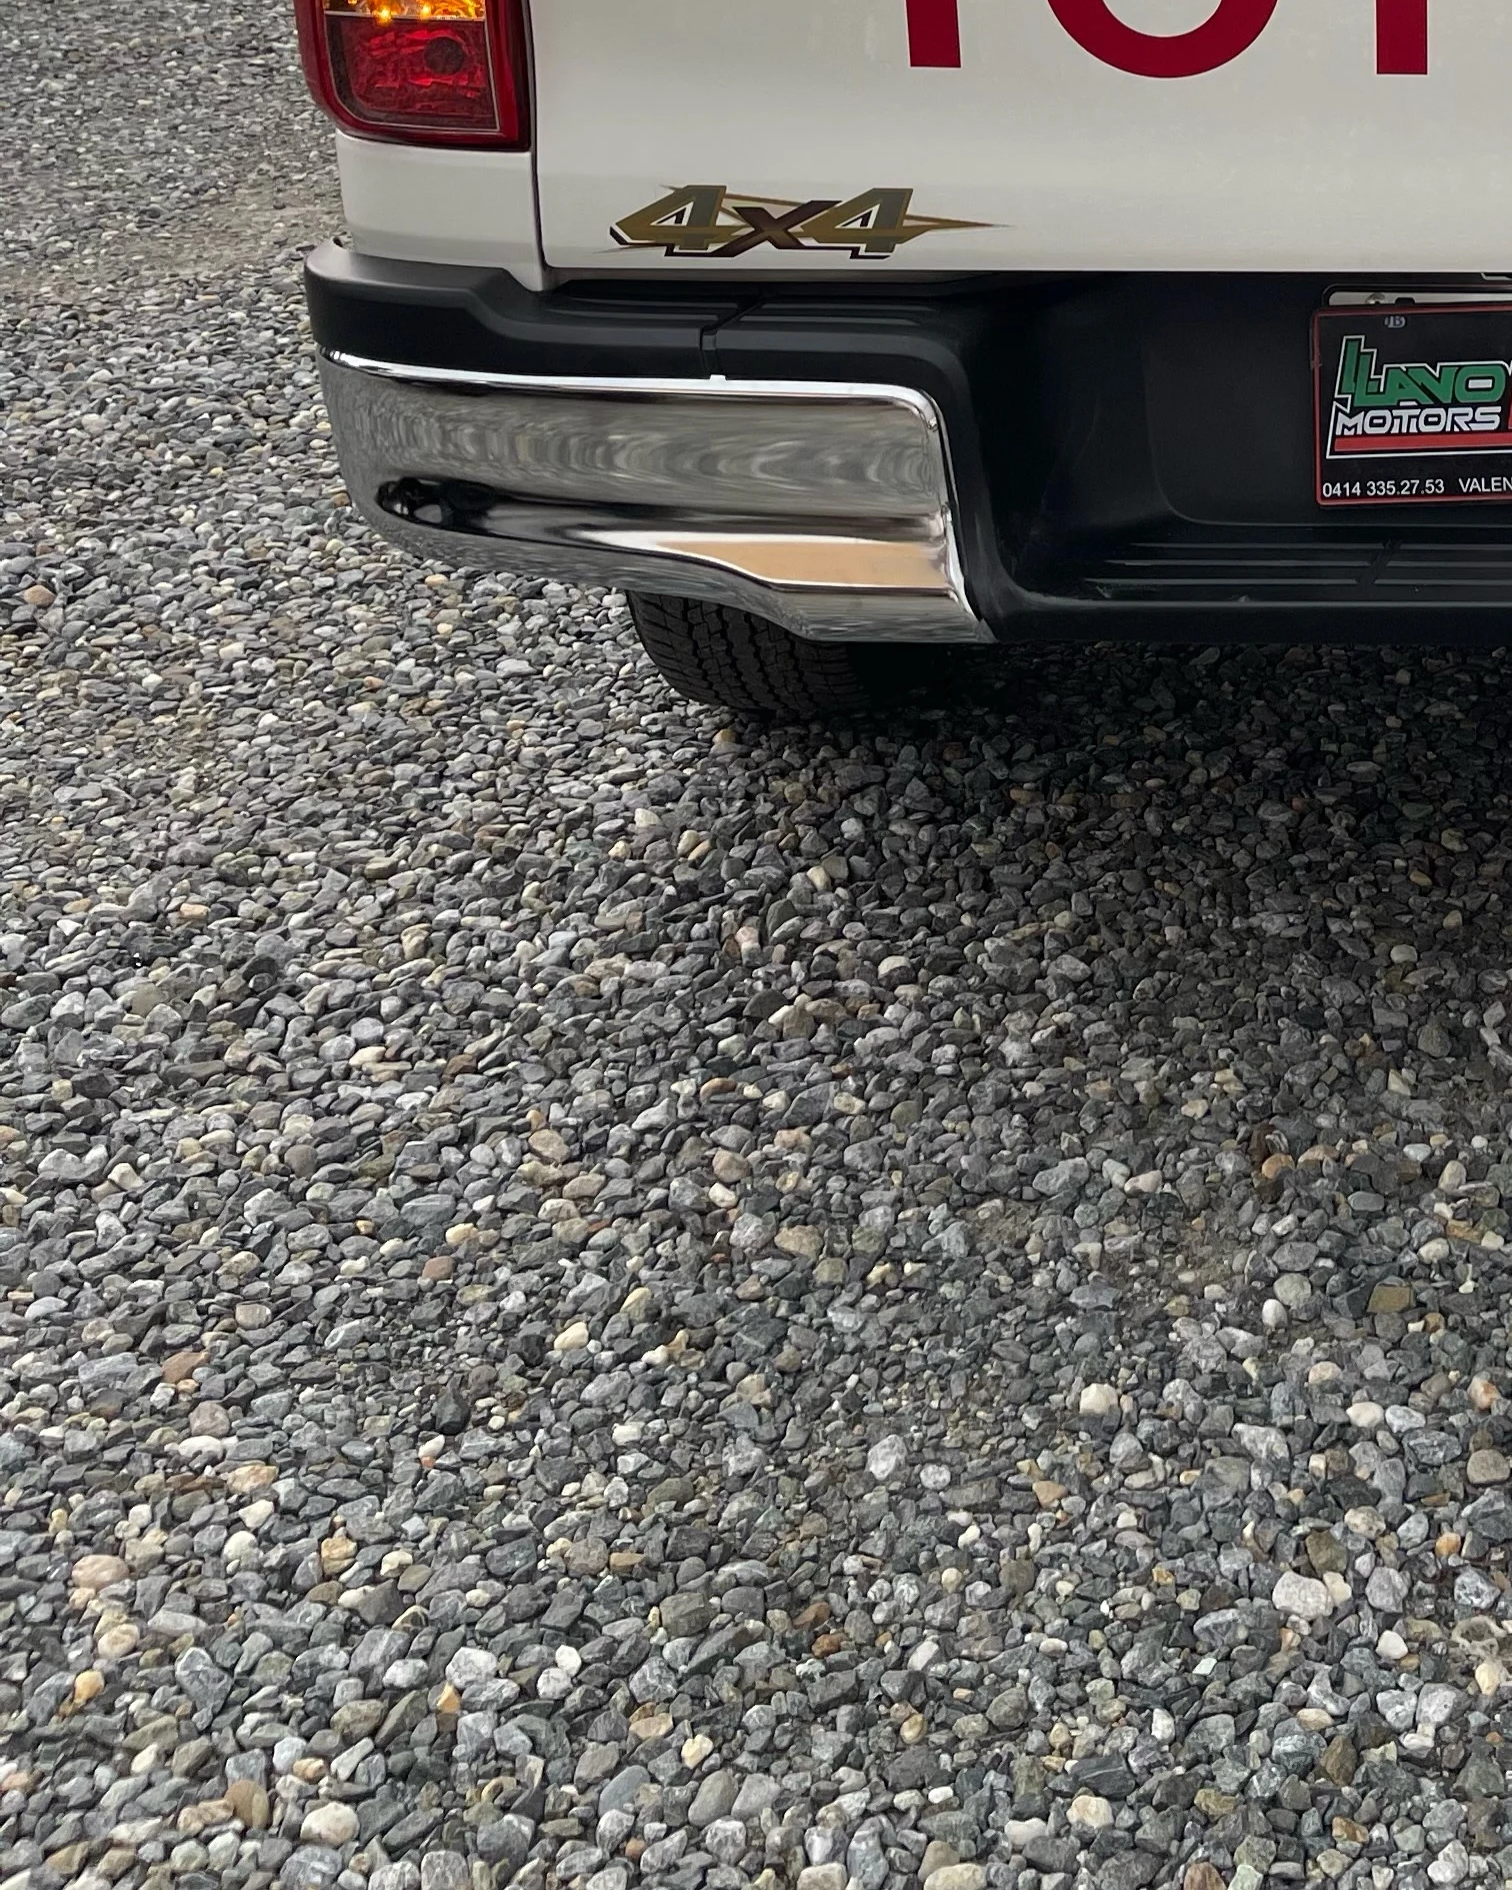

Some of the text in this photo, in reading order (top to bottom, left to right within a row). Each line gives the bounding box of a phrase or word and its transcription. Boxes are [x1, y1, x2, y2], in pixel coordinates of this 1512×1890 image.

[1341, 338, 1507, 407] LLANO
[1335, 406, 1502, 436] MOTORS
[1322, 481, 1361, 498] 0414
[1366, 479, 1445, 496] 335.27.53
